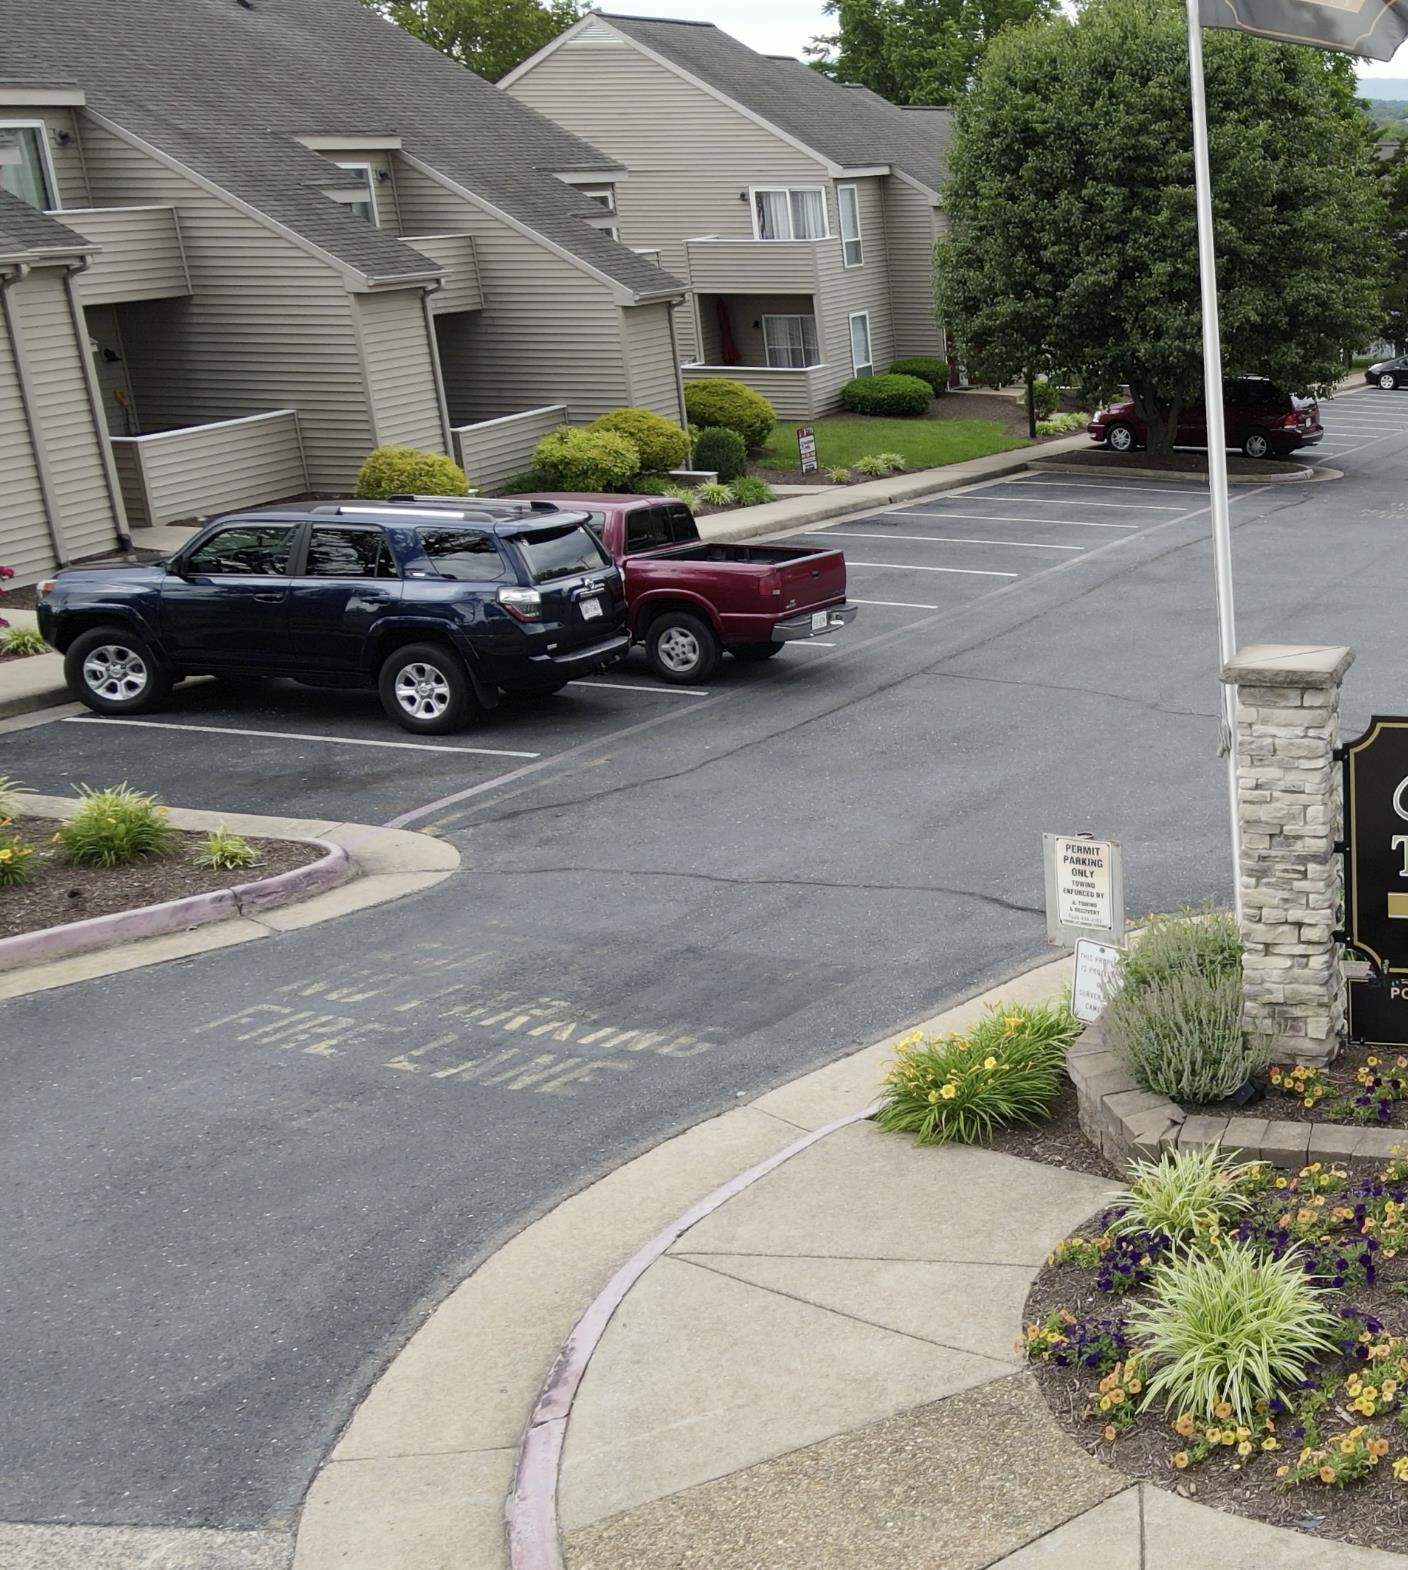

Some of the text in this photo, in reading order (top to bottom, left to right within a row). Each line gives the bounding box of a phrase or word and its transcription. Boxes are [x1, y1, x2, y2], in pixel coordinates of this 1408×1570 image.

[1065, 843, 1101, 857] PERMIT
[1063, 855, 1104, 869] PARKING
[1071, 867, 1095, 879] ONLY
[1072, 880, 1096, 889] TOWING
